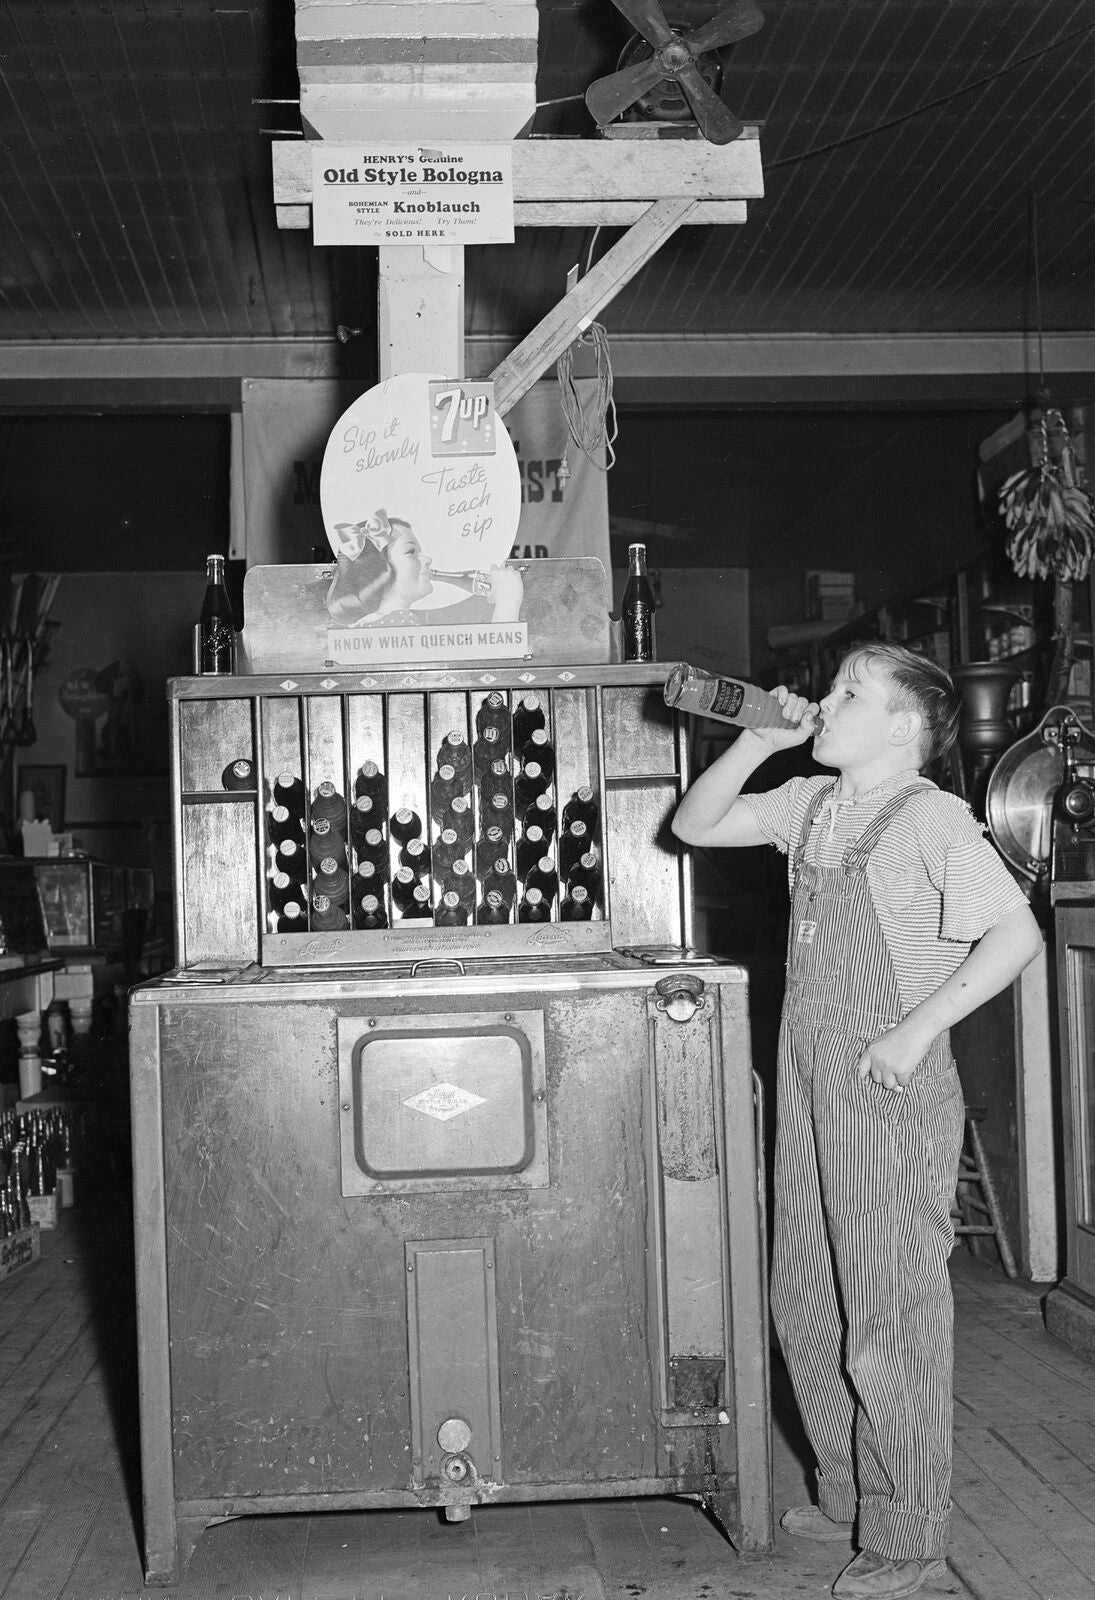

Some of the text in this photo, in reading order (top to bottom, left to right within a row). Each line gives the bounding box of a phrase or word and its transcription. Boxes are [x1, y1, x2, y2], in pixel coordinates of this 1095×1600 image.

[363, 155, 415, 164] HENRY'S
[323, 168, 504, 186] Old Style Bologna
[393, 201, 481, 214] Knoblauch
[354, 217, 478, 226] They're Delicious! Try Them!
[343, 417, 401, 455] Sip it
[355, 439, 420, 473] slowly
[420, 462, 488, 496] Taste
[447, 482, 491, 517] each
[461, 515, 493, 542] sip
[333, 631, 523, 652] KNOW WHAT QUENCH MEANS
